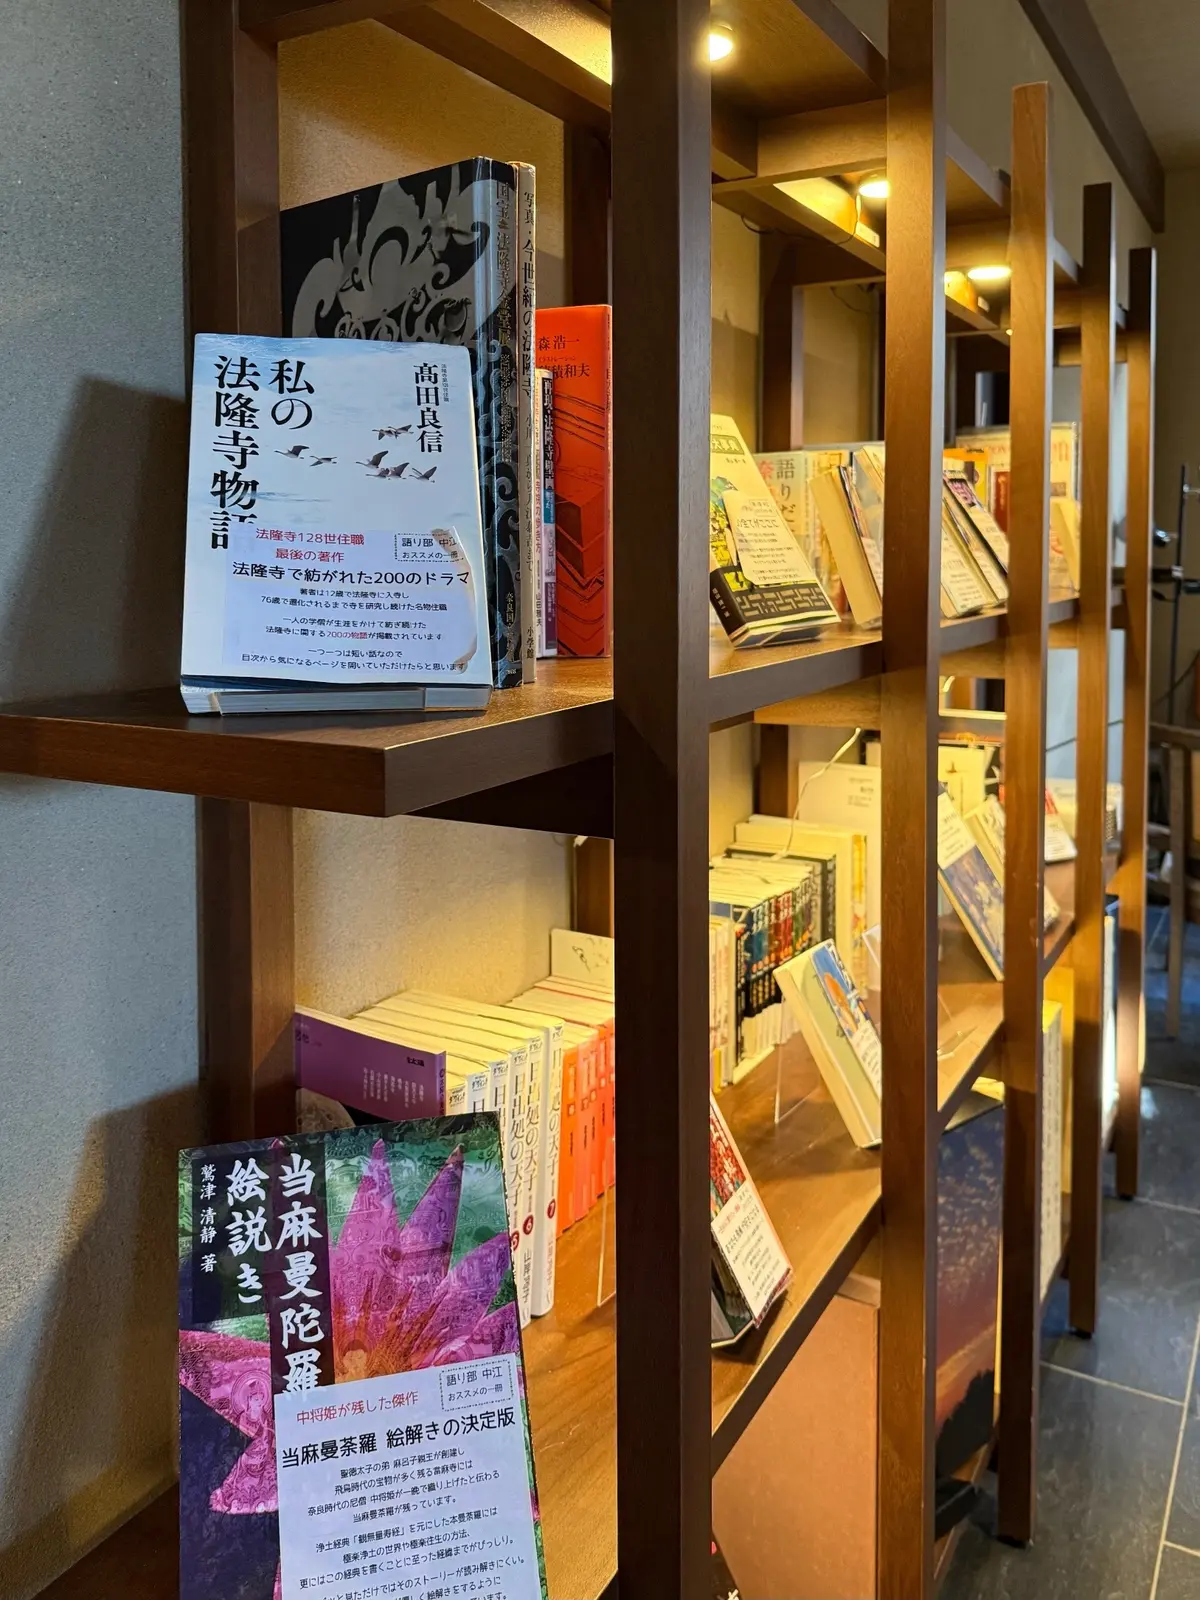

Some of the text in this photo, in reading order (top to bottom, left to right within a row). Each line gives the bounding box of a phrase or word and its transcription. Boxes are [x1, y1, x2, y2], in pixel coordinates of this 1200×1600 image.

[268, 358, 315, 430] 私の
[256, 528, 365, 546] 法隆寺128世住職
[401, 536, 457, 548] 語り部 中江
[275, 548, 345, 563] 最後の著作
[402, 551, 458, 560] おススメの一冊
[232, 561, 470, 586] 法隆寺で紡がれた200のドラマ
[299, 588, 410, 599] 著者は12歳で法隆寺に入寺し
[265, 625, 442, 640] 法隆寺に関する200の物語が掲載されています
[283, 616, 427, 629] 一人の学僧が生涯をかけて紡ぎ続けた
[308, 648, 403, 658] 一つ一つは短い話なので
[526, 626, 534, 659] 小学館
[241, 653, 465, 671] 目次から気になるページを開いていただけたらと思います
[509, 1073, 525, 1206] 日出処の天子
[524, 1062, 541, 1191] 日出処の天子
[200, 1163, 217, 1273] 鷲津 清静 著
[225, 1158, 272, 1304] 絵説き
[275, 1153, 326, 1392] 当麻曼陀羅
[446, 1366, 503, 1387] 語り部 中江
[448, 1383, 503, 1402] おススメの一冊
[296, 1390, 419, 1425] 中将姫が残した傑作
[282, 1406, 516, 1469] 当麻曼荼羅 絵解きの決定版
[340, 1447, 465, 1479] 聖徳太子の弟 麻呂子親王が創建し
[307, 1470, 500, 1517] 奈良時代の尼僧 中将姫が一晩で織り上げたと伝わる
[300, 1535, 514, 1590] 更にはこの経典を書くことに至った経緯までがびっしり。
[342, 1529, 470, 1564] 極楽浄土の世界や極楽往生の方法、
[323, 1556, 525, 1600] と見ただけではそのストーリーが読み解きにくい。
[395, 1576, 502, 1600] く絵解きをするように
